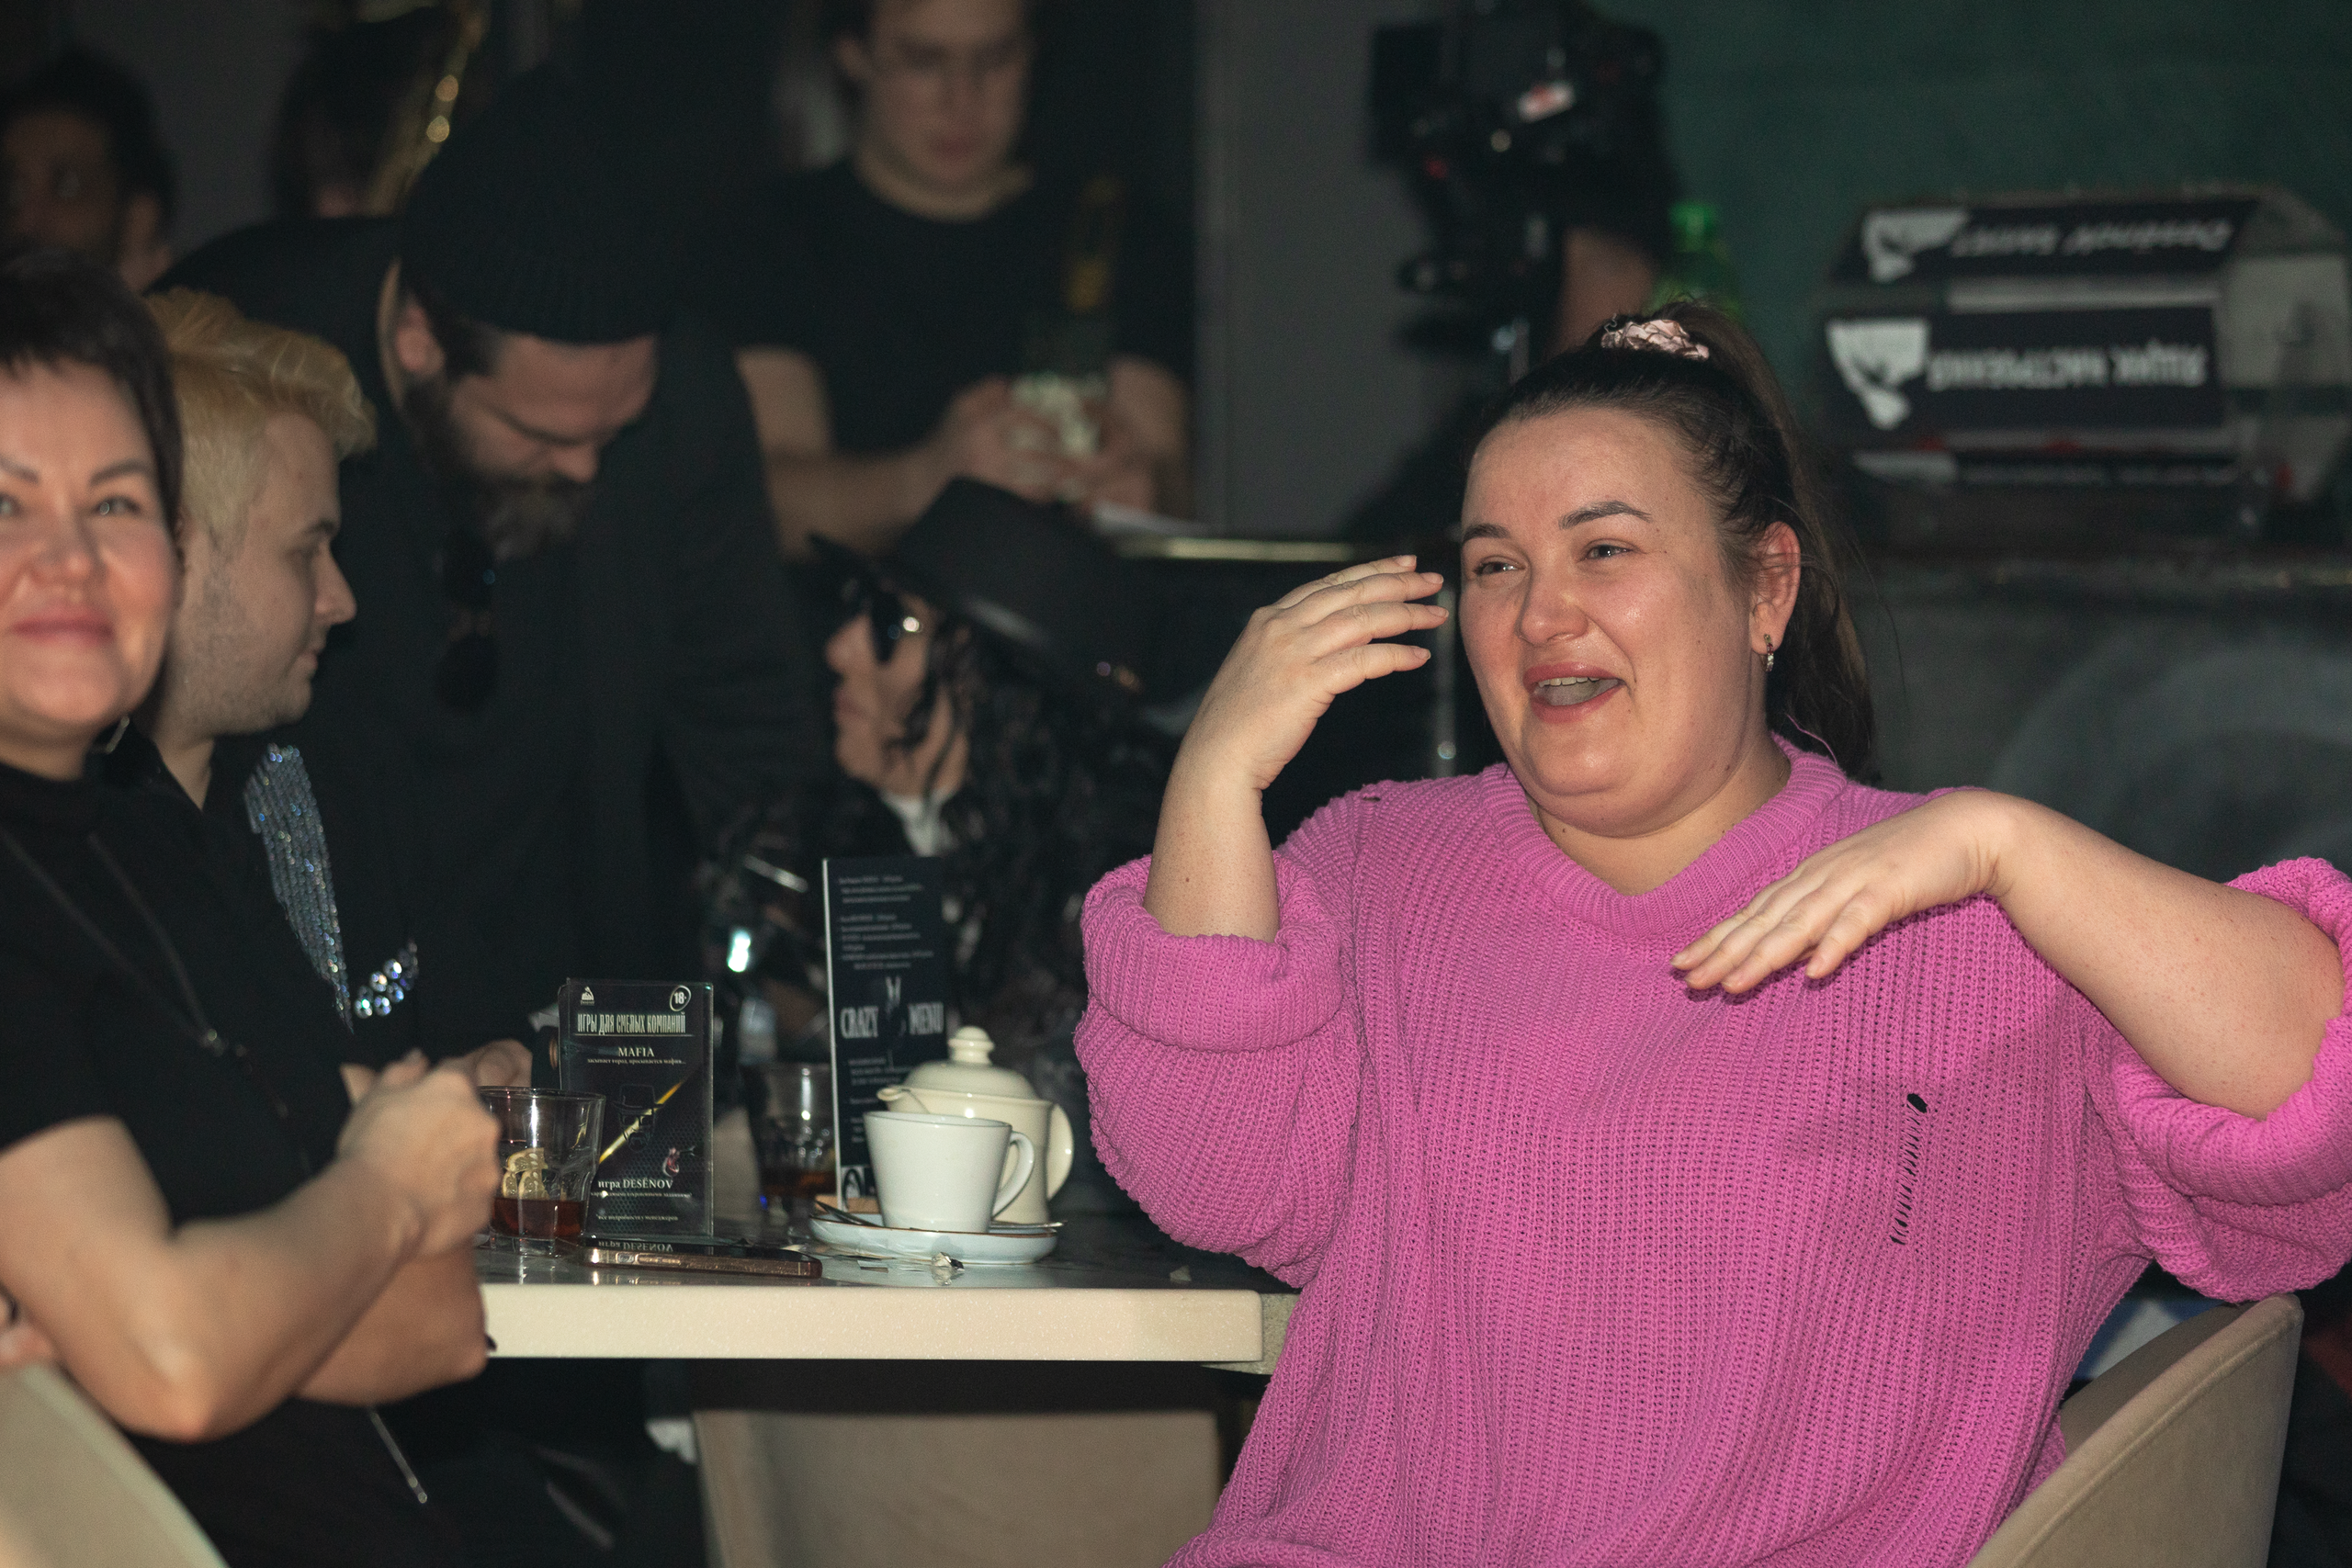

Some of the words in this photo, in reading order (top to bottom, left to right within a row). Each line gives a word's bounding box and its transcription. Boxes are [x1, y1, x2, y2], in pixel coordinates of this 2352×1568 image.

[577, 1013, 597, 1032] ИГРЫ
[598, 1013, 615, 1036] ДЛЯ
[616, 1013, 645, 1033] СМЕЛЫХ
[647, 1011, 686, 1034] КОМПАНИЙ
[840, 1005, 879, 1038] CRAZY
[908, 1001, 945, 1035] MENU
[618, 1046, 655, 1057] MAFIA
[597, 1179, 620, 1190] игра
